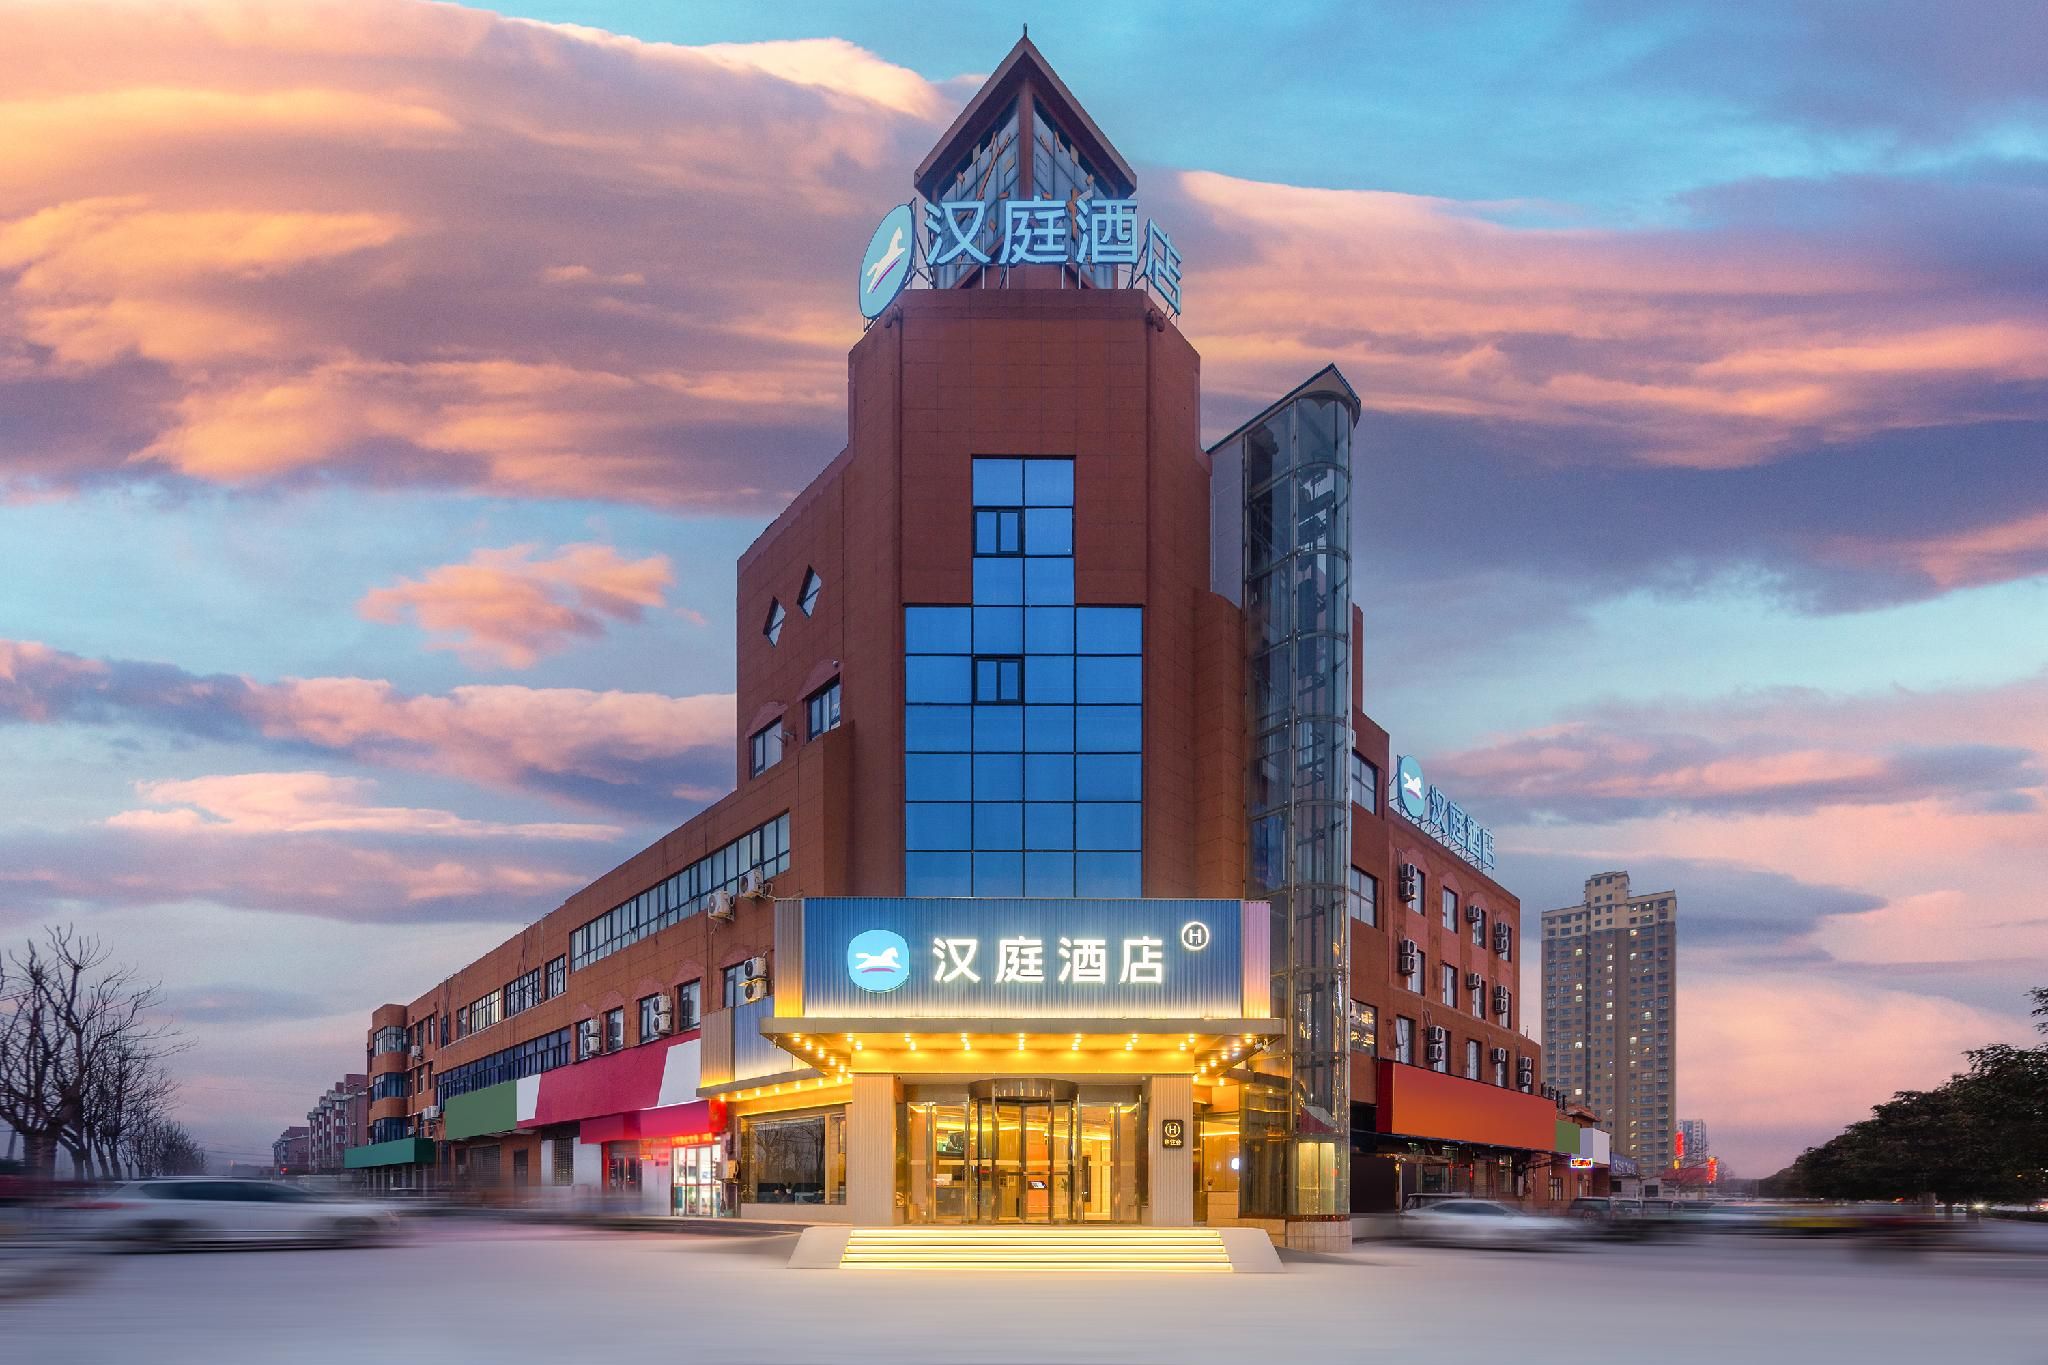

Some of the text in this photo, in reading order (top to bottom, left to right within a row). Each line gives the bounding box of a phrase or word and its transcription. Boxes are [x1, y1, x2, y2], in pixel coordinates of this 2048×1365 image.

[925, 196, 1181, 315] 汉庭酒店
[933, 936, 1164, 984] 汉庭酒店
